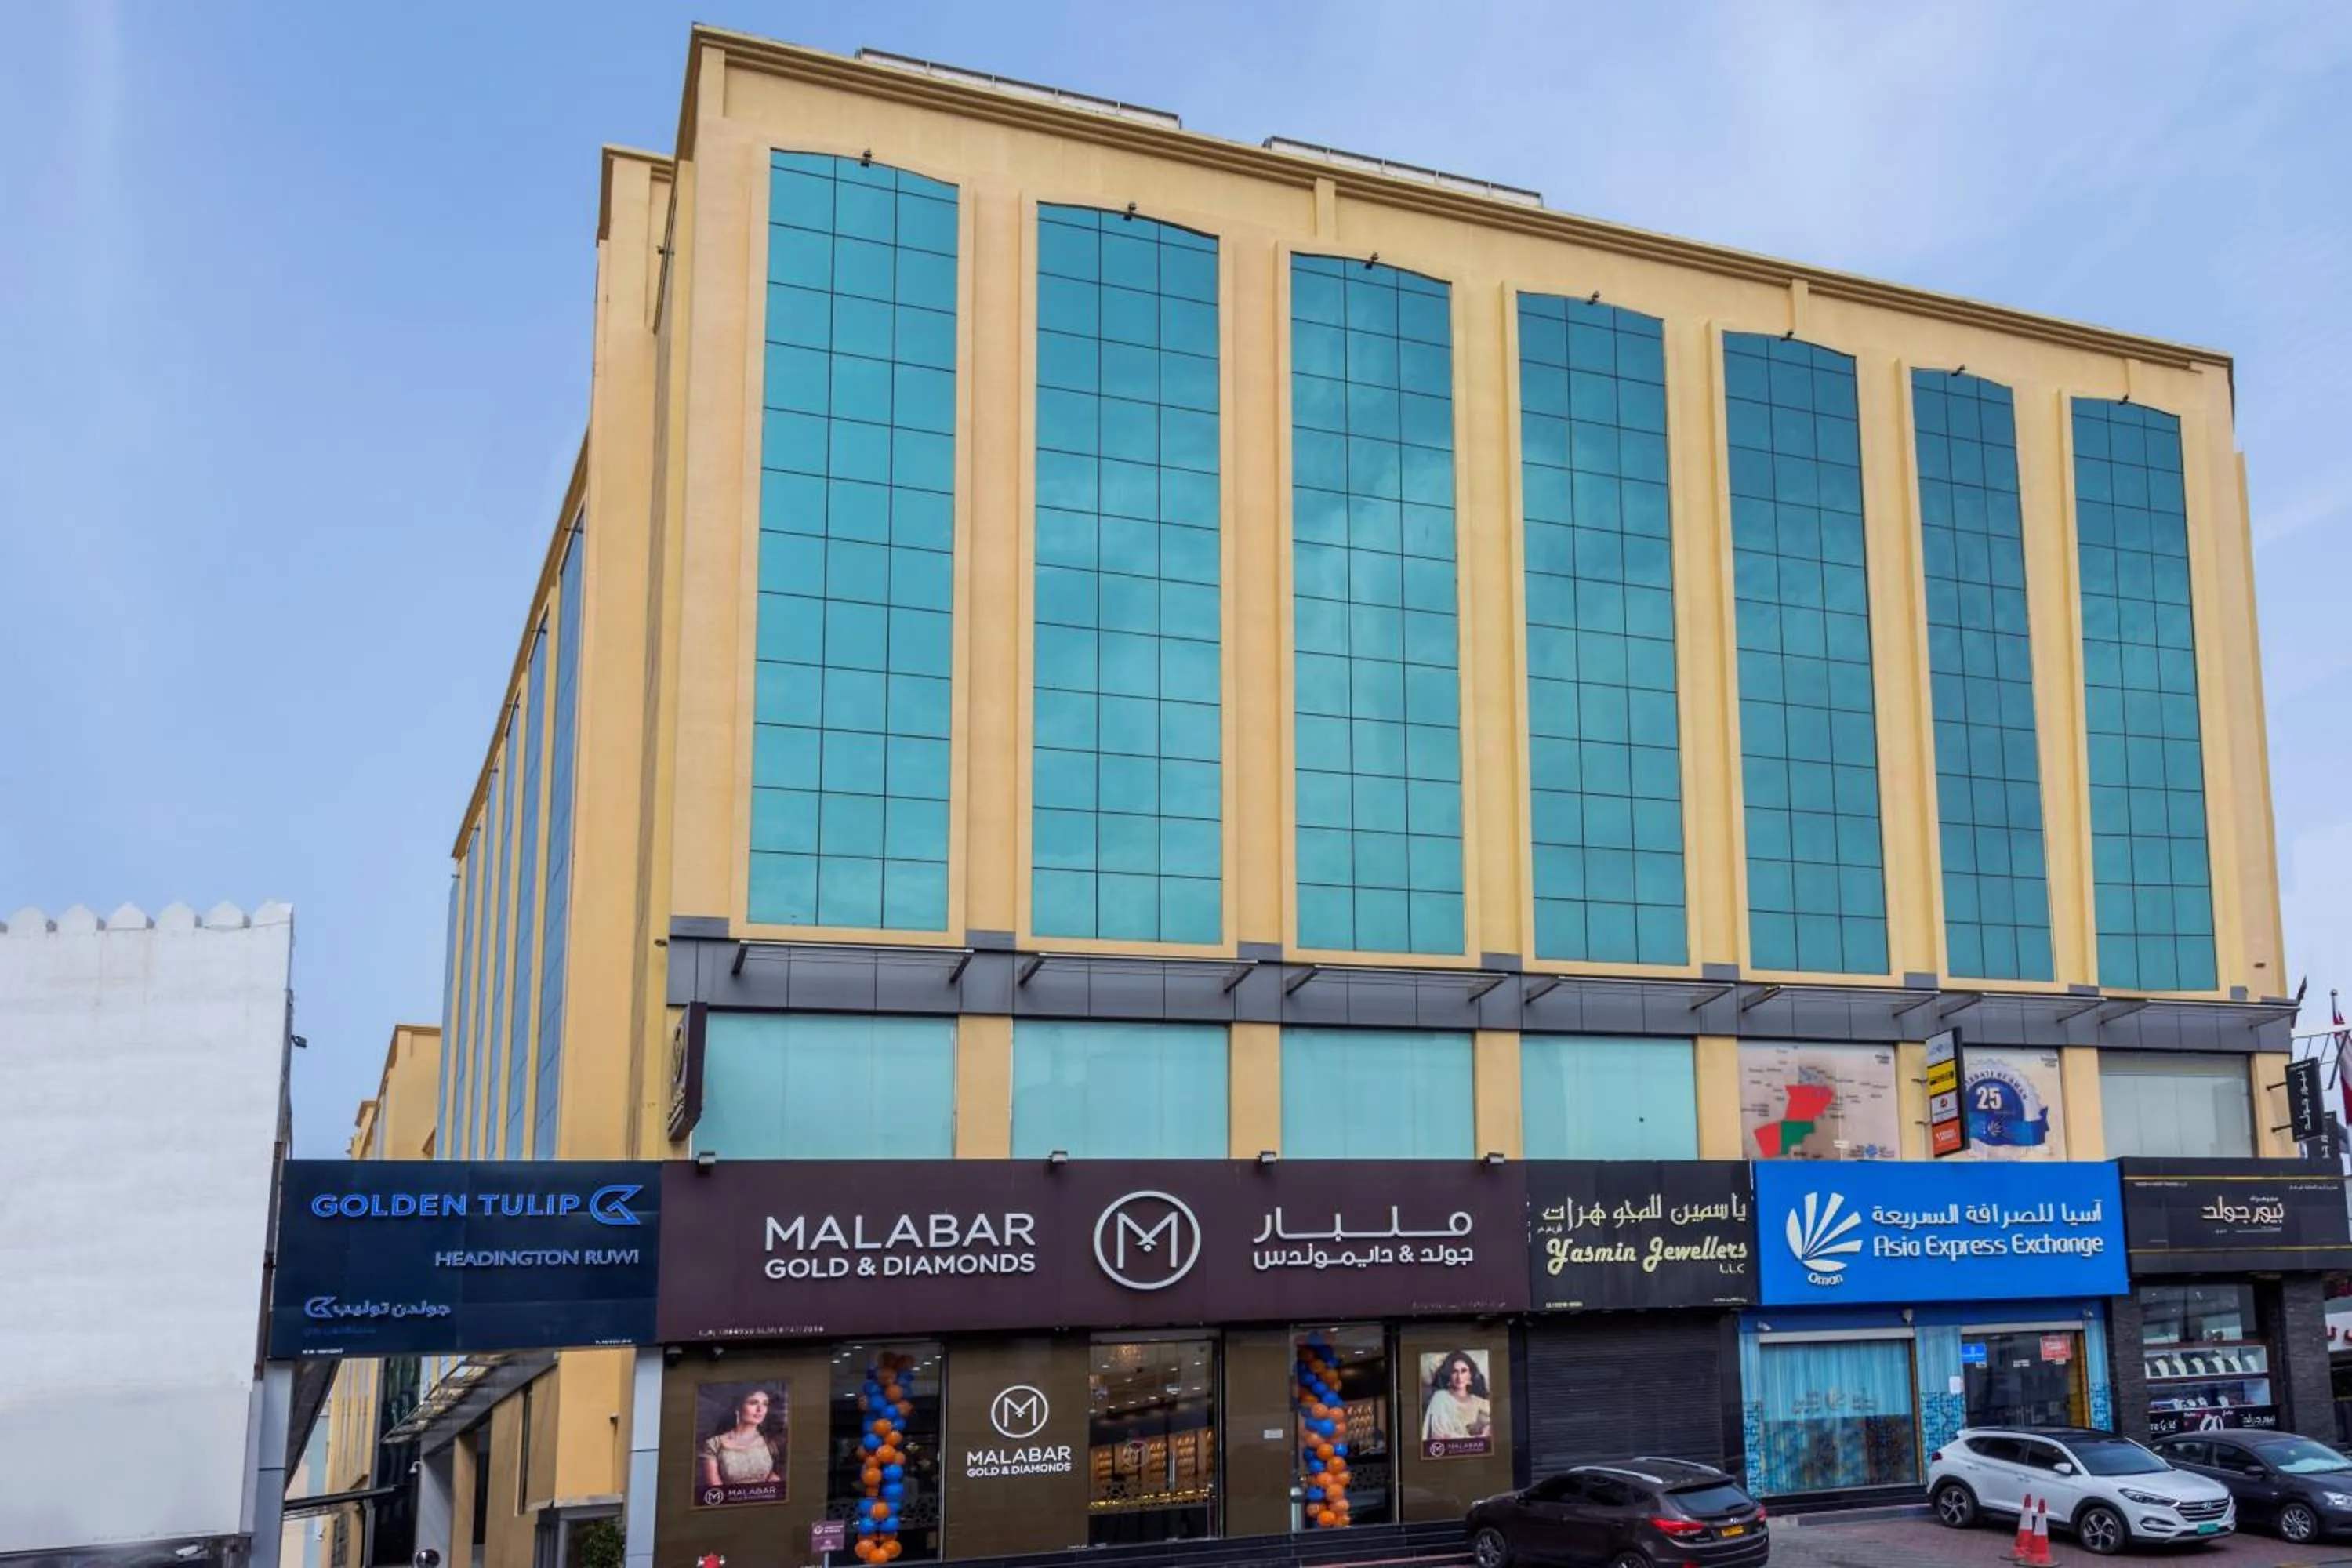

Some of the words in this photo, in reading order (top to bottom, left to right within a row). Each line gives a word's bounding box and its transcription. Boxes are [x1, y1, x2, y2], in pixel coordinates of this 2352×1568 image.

[1977, 1087, 2002, 1109] 25
[312, 1193, 466, 1217] GOLDEN
[477, 1193, 581, 1216] TULIP
[1670, 1192, 1747, 1225] ياسمين
[1872, 1203, 1959, 1230] السريعة
[1965, 1202, 2054, 1229] للصرافة
[2061, 1199, 2103, 1226] آسيا
[2201, 1195, 2251, 1225] جولد
[765, 1213, 1036, 1250] MALABAR
[1253, 1206, 1473, 1243] ملبار
[434, 1250, 579, 1267] HEADINGTON
[585, 1250, 640, 1265] RUWI
[1399, 1245, 1414, 1264] &
[1420, 1243, 1474, 1266] جولد
[1546, 1237, 1637, 1276] Yasmin
[1642, 1236, 1748, 1273] Jewellers
[1873, 1235, 1920, 1257] Asia
[1926, 1234, 2007, 1261] Express
[2012, 1233, 2104, 1258] Exchange
[765, 1258, 848, 1279] GOLD
[858, 1257, 877, 1276] &
[884, 1254, 1036, 1277] DIAMONDS
[1807, 1272, 1844, 1286] Oman
[967, 1446, 1072, 1467] MALABAR
[967, 1467, 1000, 1478] GOLD
[1001, 1465, 1009, 1475] &
[1011, 1462, 1072, 1475] DIAMONDS
[728, 1486, 776, 1496] MALABAR
